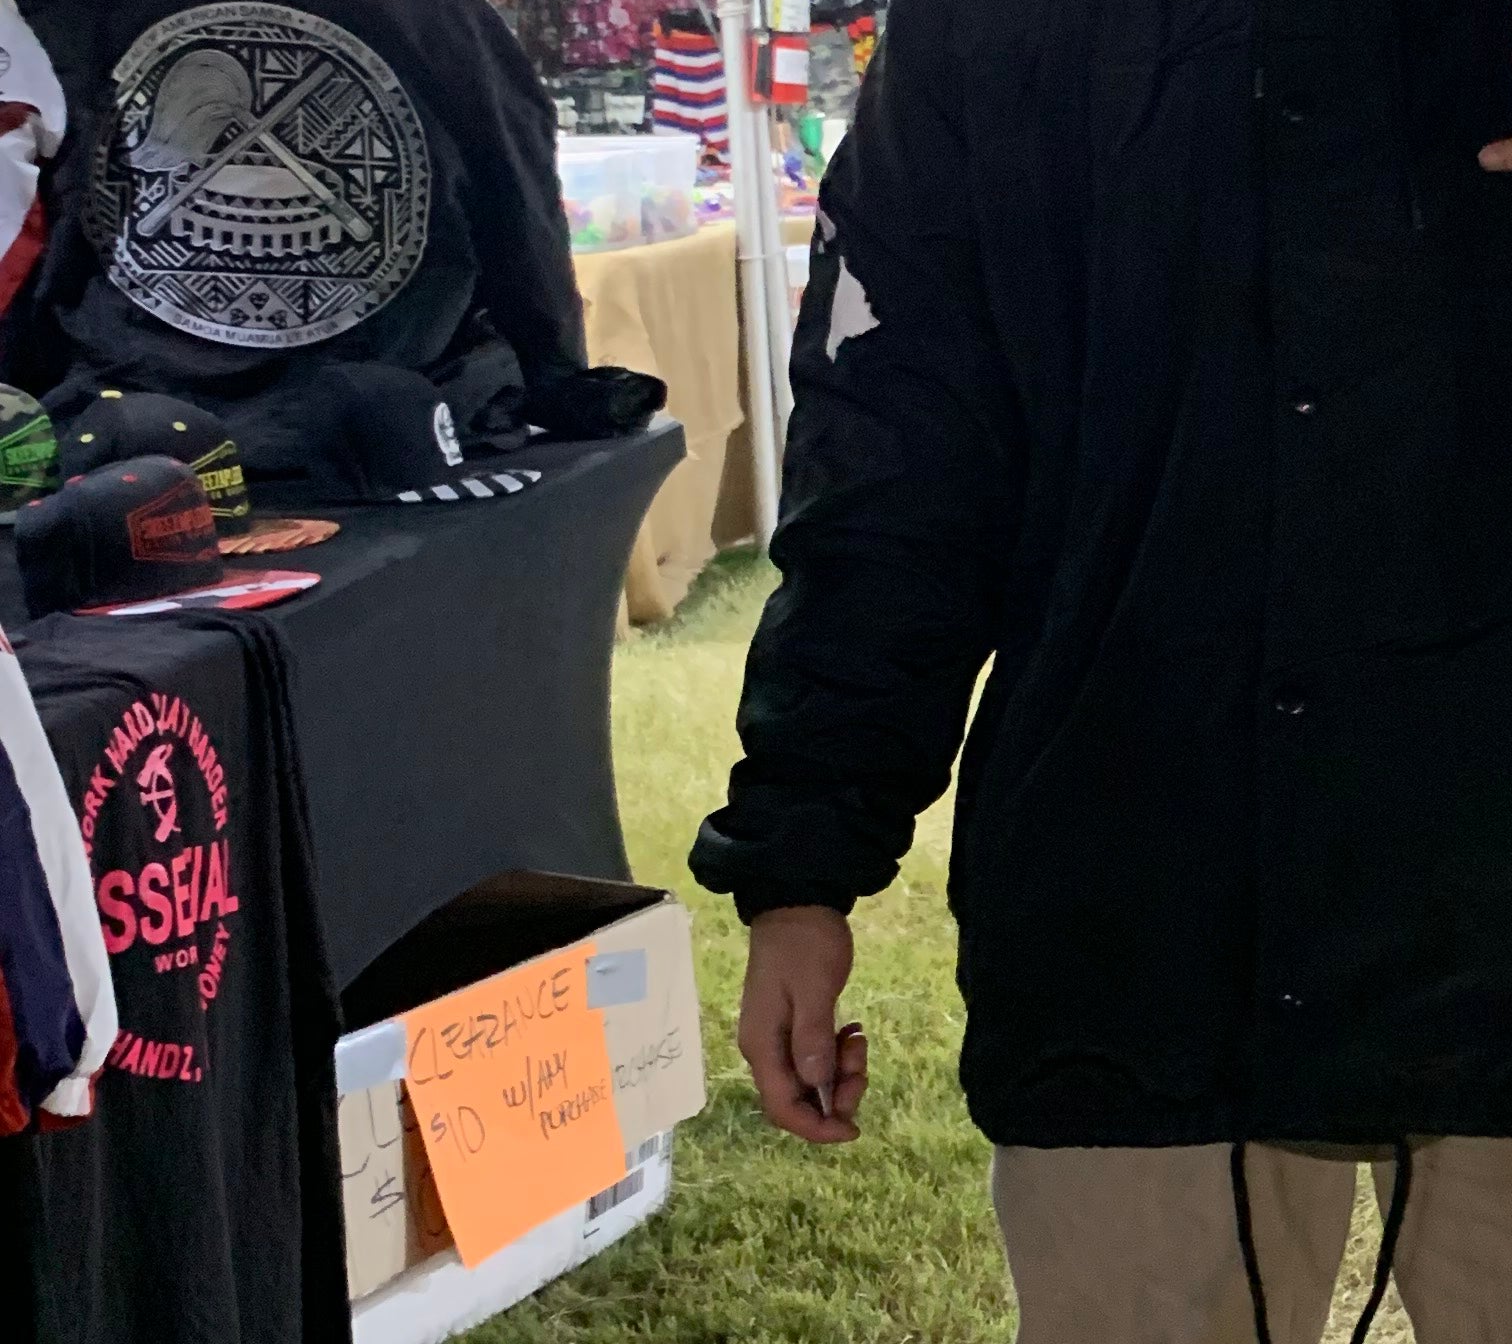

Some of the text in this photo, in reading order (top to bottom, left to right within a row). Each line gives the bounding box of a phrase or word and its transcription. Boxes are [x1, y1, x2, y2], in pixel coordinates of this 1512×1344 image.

[104, 701, 155, 775] HARD
[198, 921, 230, 1011] ONEY
[408, 967, 572, 1086] CLEARANCE
